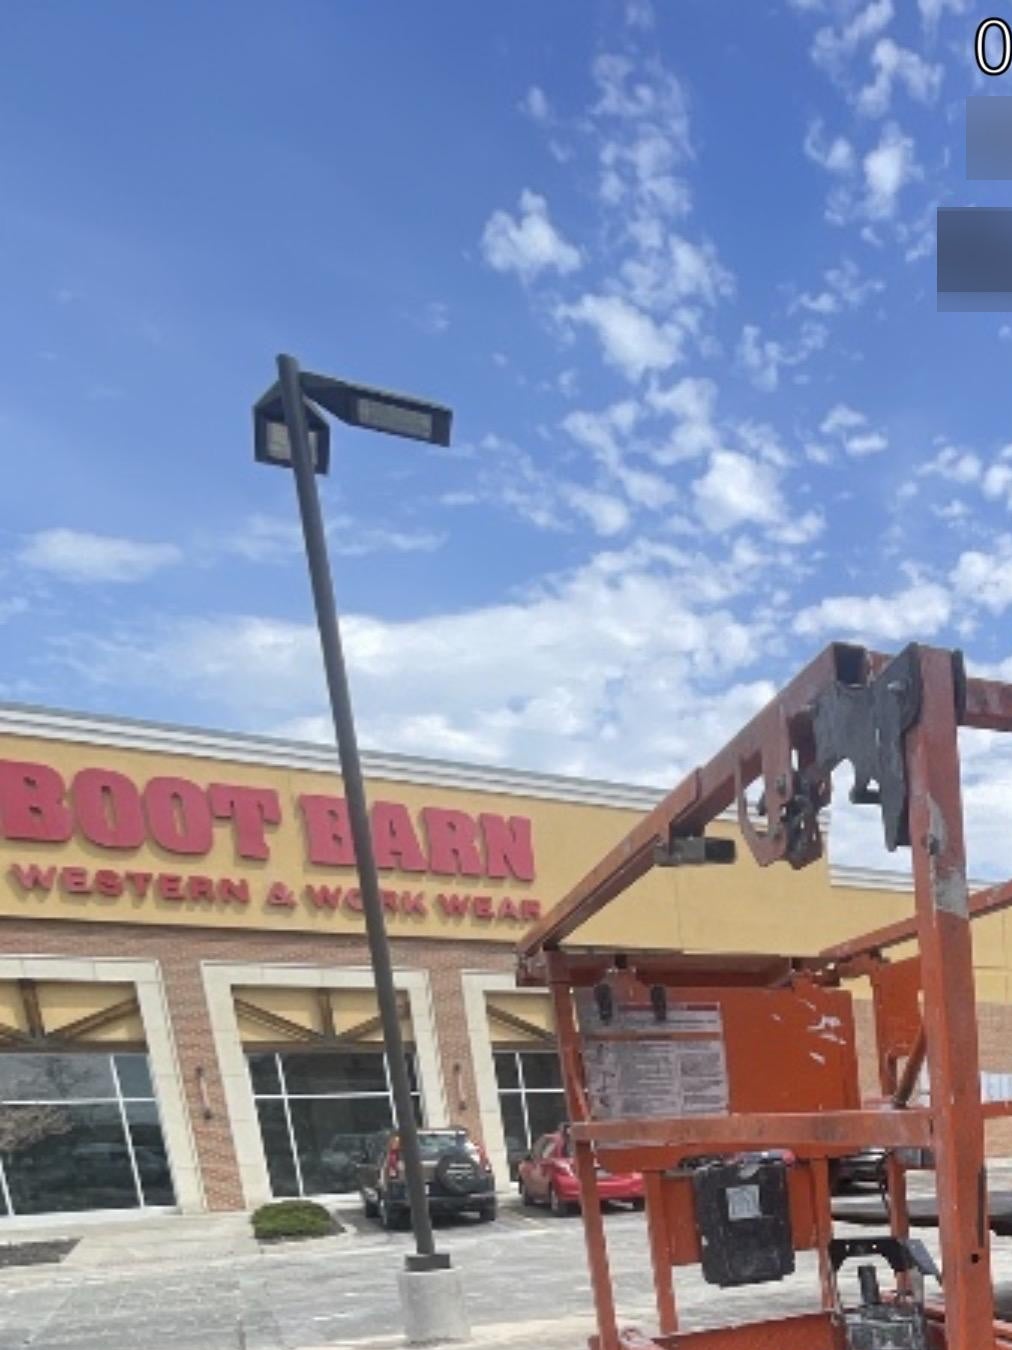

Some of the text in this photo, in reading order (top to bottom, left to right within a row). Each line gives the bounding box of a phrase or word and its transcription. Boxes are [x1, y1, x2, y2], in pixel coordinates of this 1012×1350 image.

[0, 758, 534, 882] BOOT BARN
[11, 863, 250, 904] WESTERN
[266, 881, 297, 909] &
[436, 892, 541, 920] WEAR
